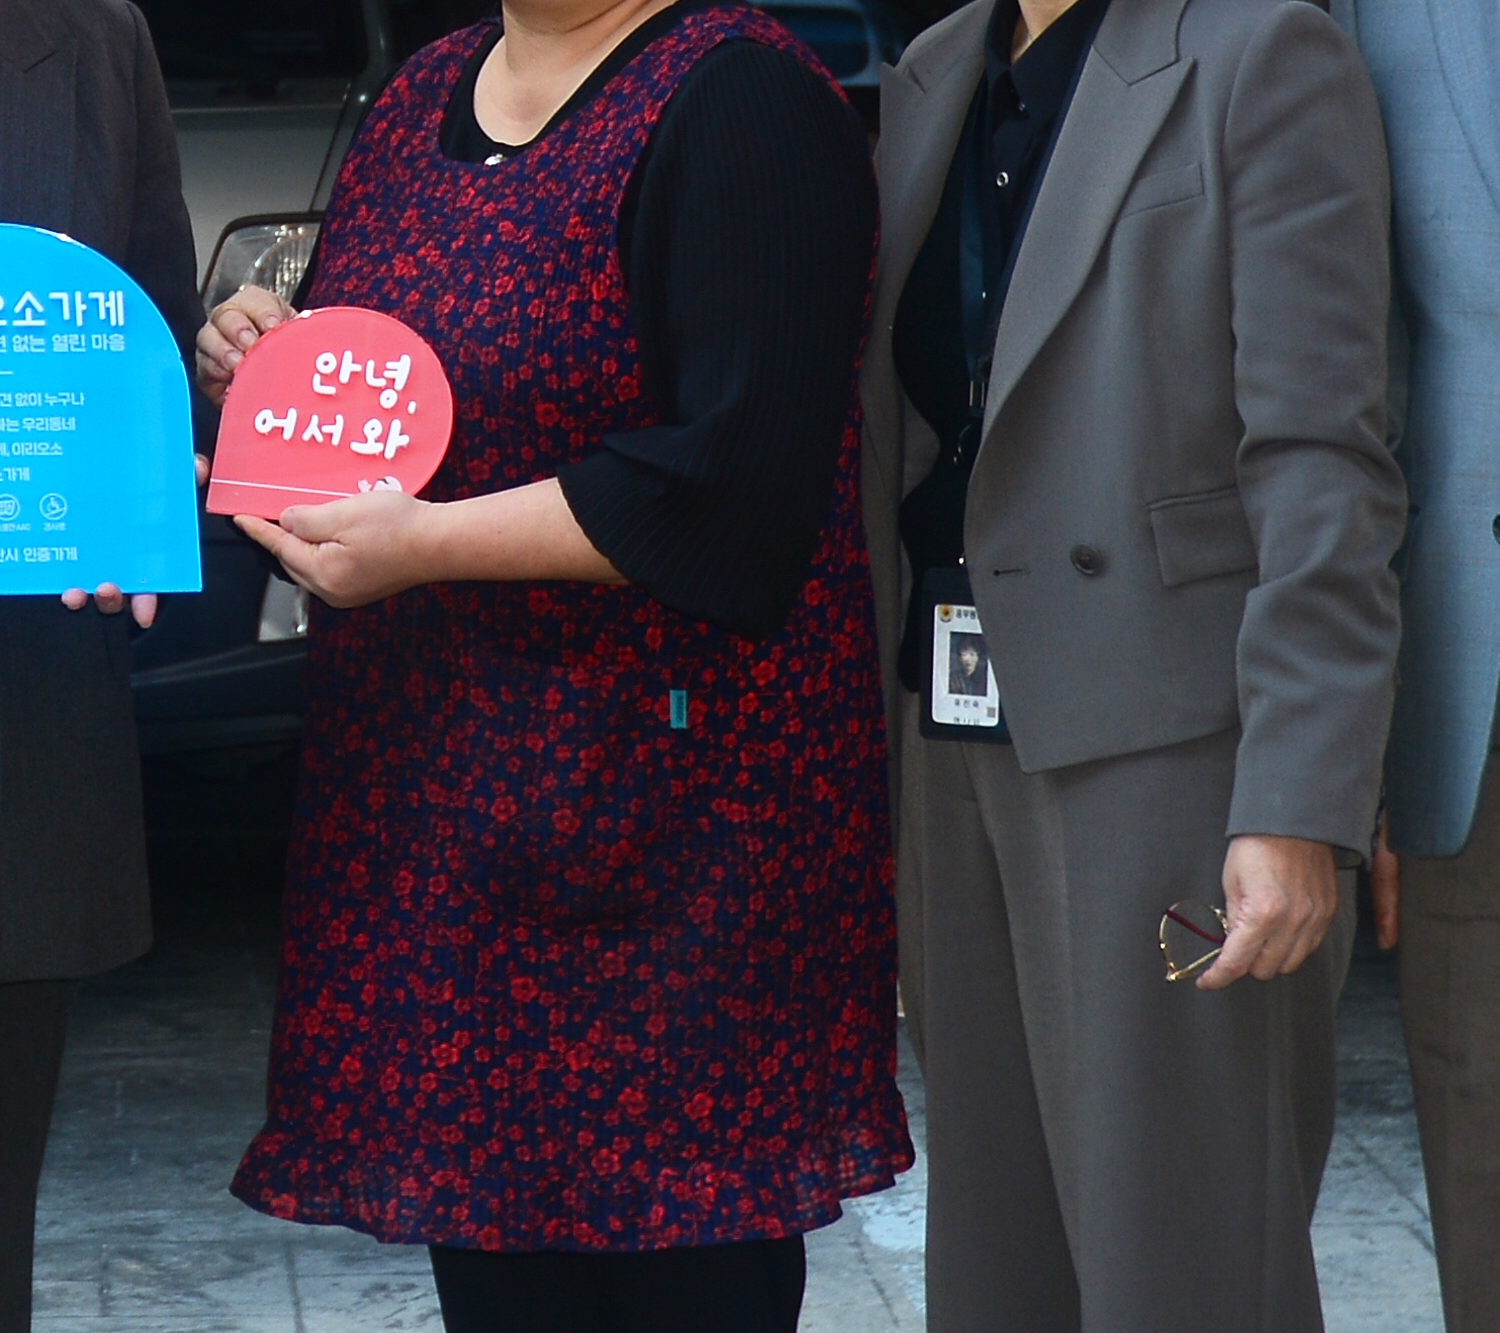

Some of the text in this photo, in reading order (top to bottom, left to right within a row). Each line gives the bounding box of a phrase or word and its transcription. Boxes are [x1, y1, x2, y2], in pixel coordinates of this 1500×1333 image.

[12, 334, 46, 353] 없는
[52, 333, 86, 353] 열린
[91, 333, 125, 352] 마음
[44, 392, 85, 407] 누구나
